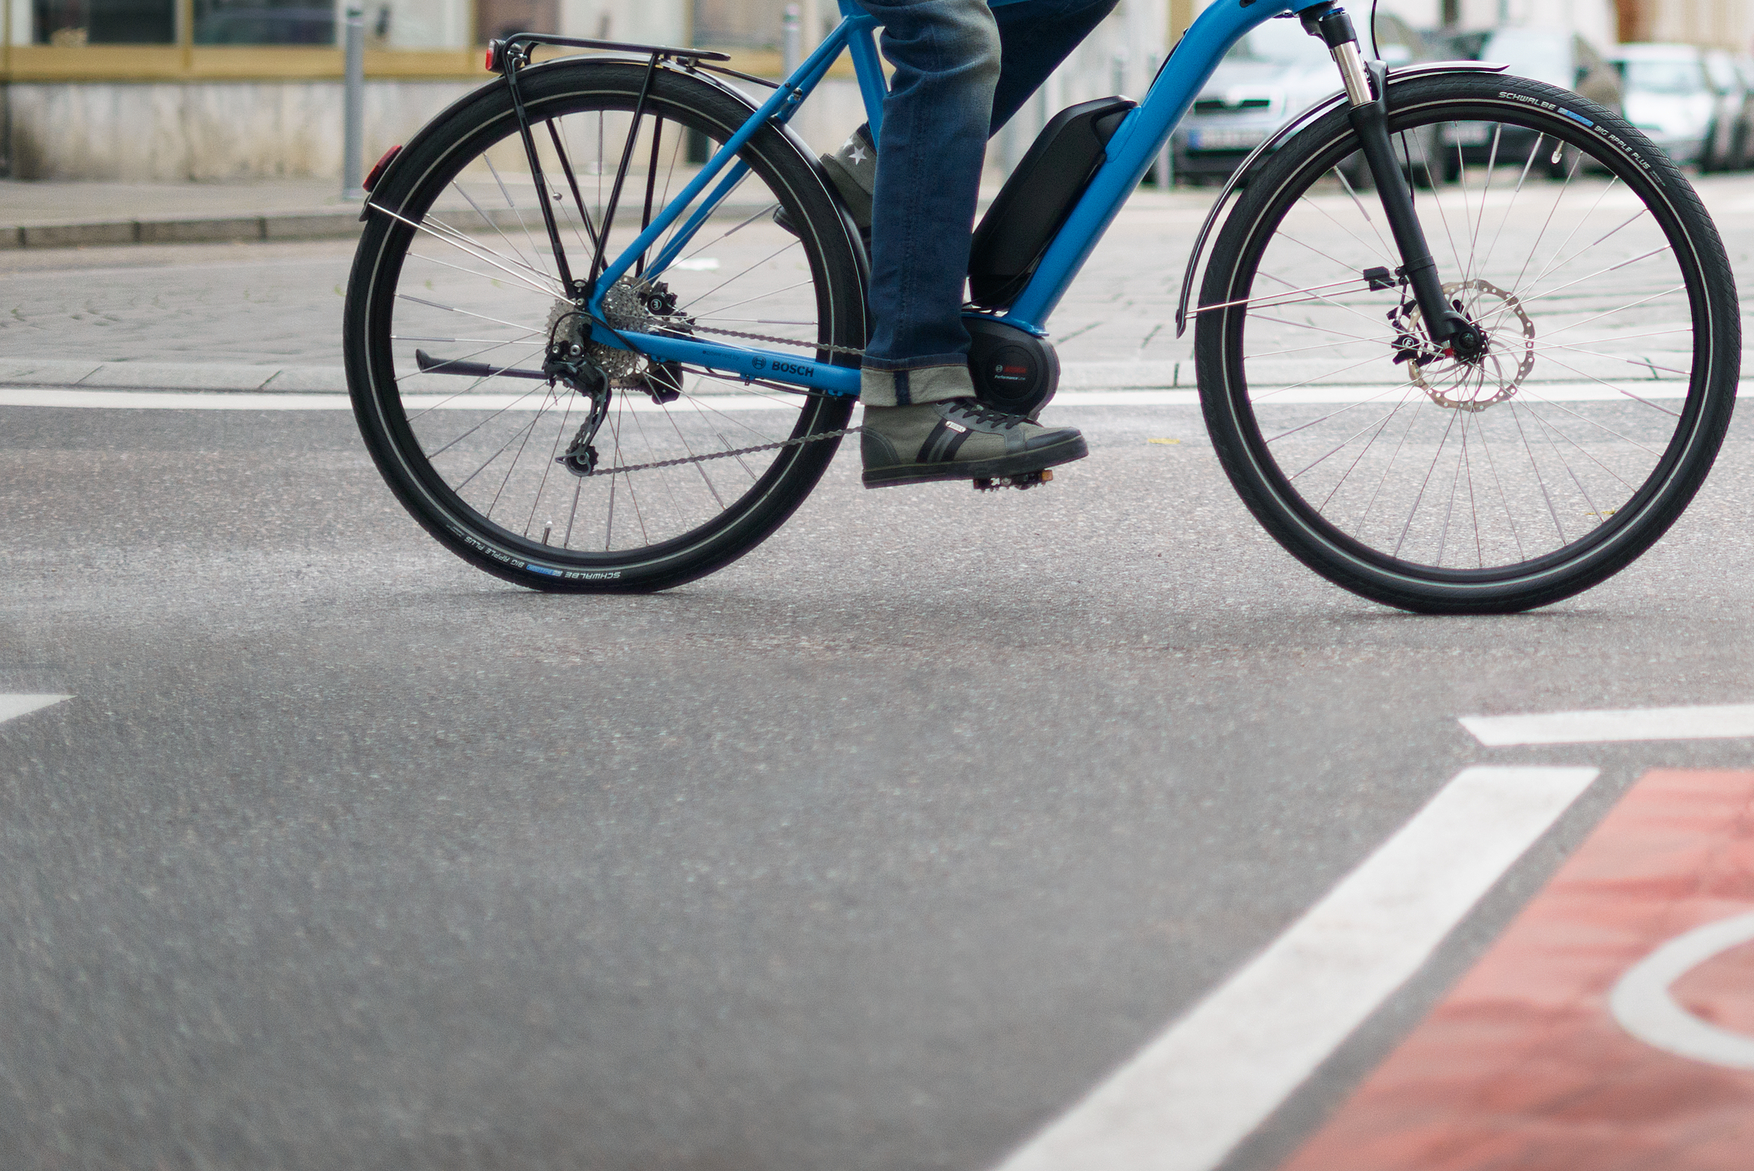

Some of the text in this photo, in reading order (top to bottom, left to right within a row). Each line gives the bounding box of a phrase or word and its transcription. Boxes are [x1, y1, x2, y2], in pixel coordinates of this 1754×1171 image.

[1498, 91, 1557, 111] SCHWALBE
[1607, 133, 1633, 155] APPLE
[1631, 151, 1651, 171] PLUS
[771, 360, 815, 378] BOSCH
[564, 571, 622, 580] SCHWALBE
